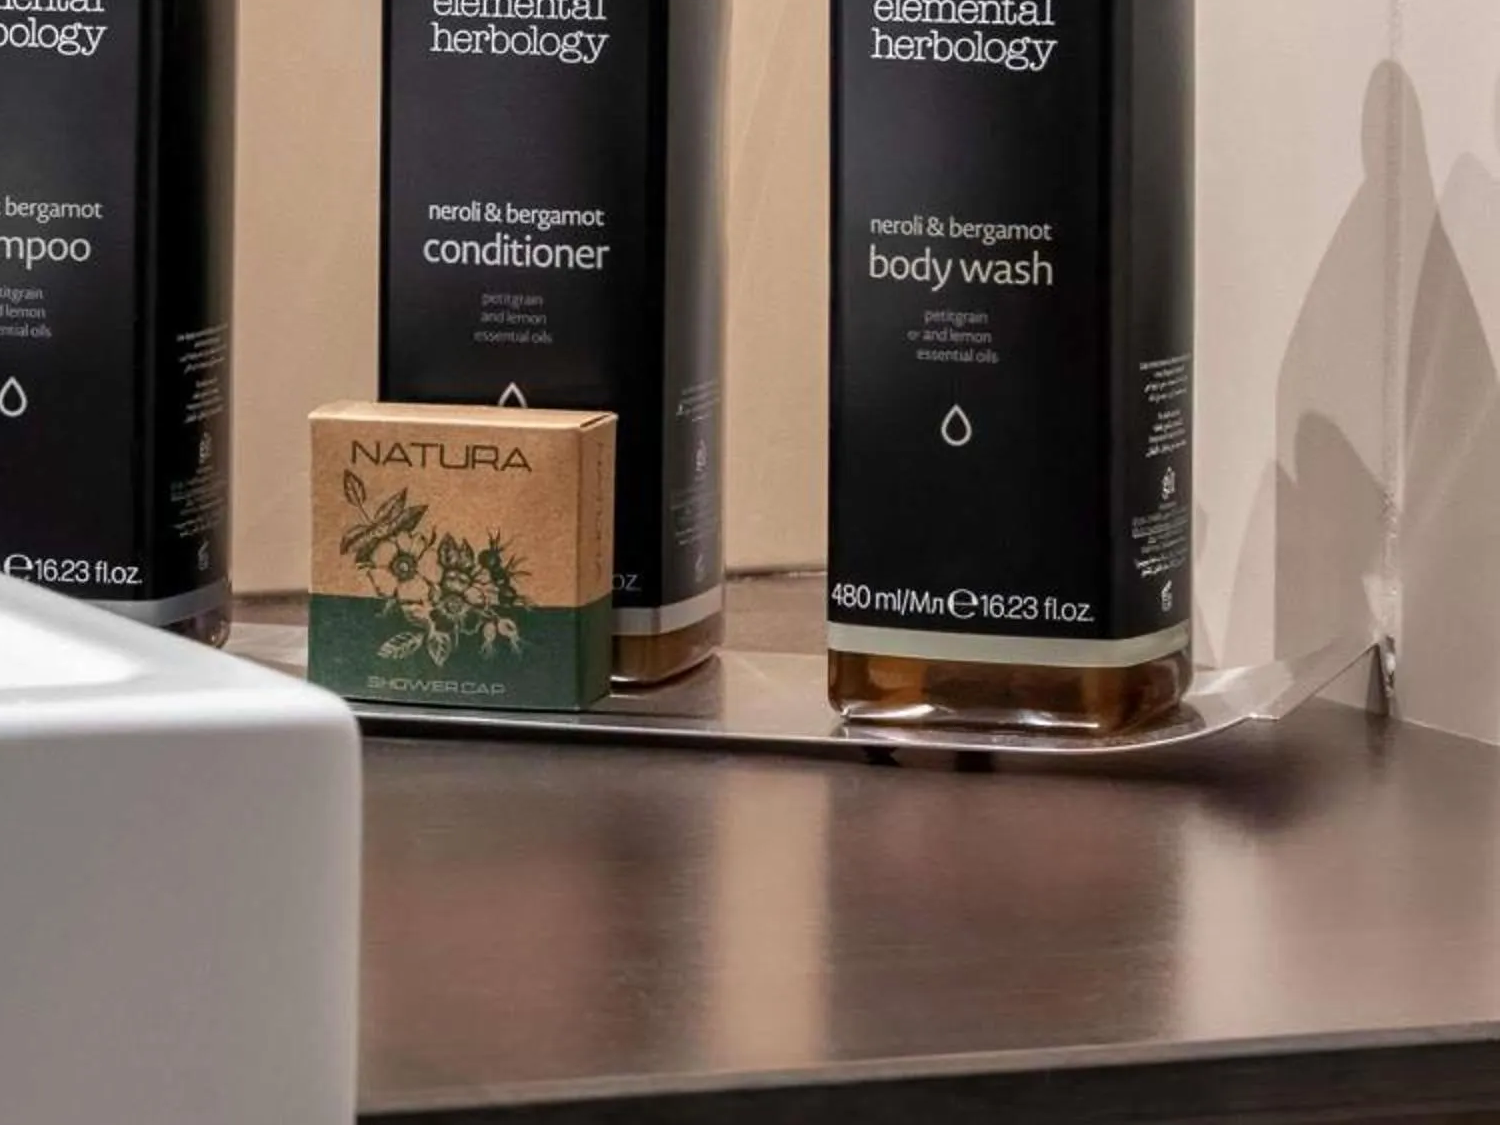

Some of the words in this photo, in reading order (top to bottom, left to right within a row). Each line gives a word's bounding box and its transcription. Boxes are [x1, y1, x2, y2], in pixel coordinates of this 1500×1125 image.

[429, 22, 610, 64] herbology
[871, 27, 1058, 71] herbology
[5, 195, 104, 224] bergamot
[428, 200, 481, 222] neroli
[484, 202, 503, 223] &
[506, 202, 605, 231] bergamot
[870, 215, 923, 236] neroli
[926, 216, 945, 237] &
[949, 215, 1053, 246] bergamot
[423, 231, 610, 269] conditioner
[869, 243, 953, 292] body
[959, 250, 1053, 286] wash
[351, 440, 532, 473] NATURA
[831, 583, 871, 609] 480
